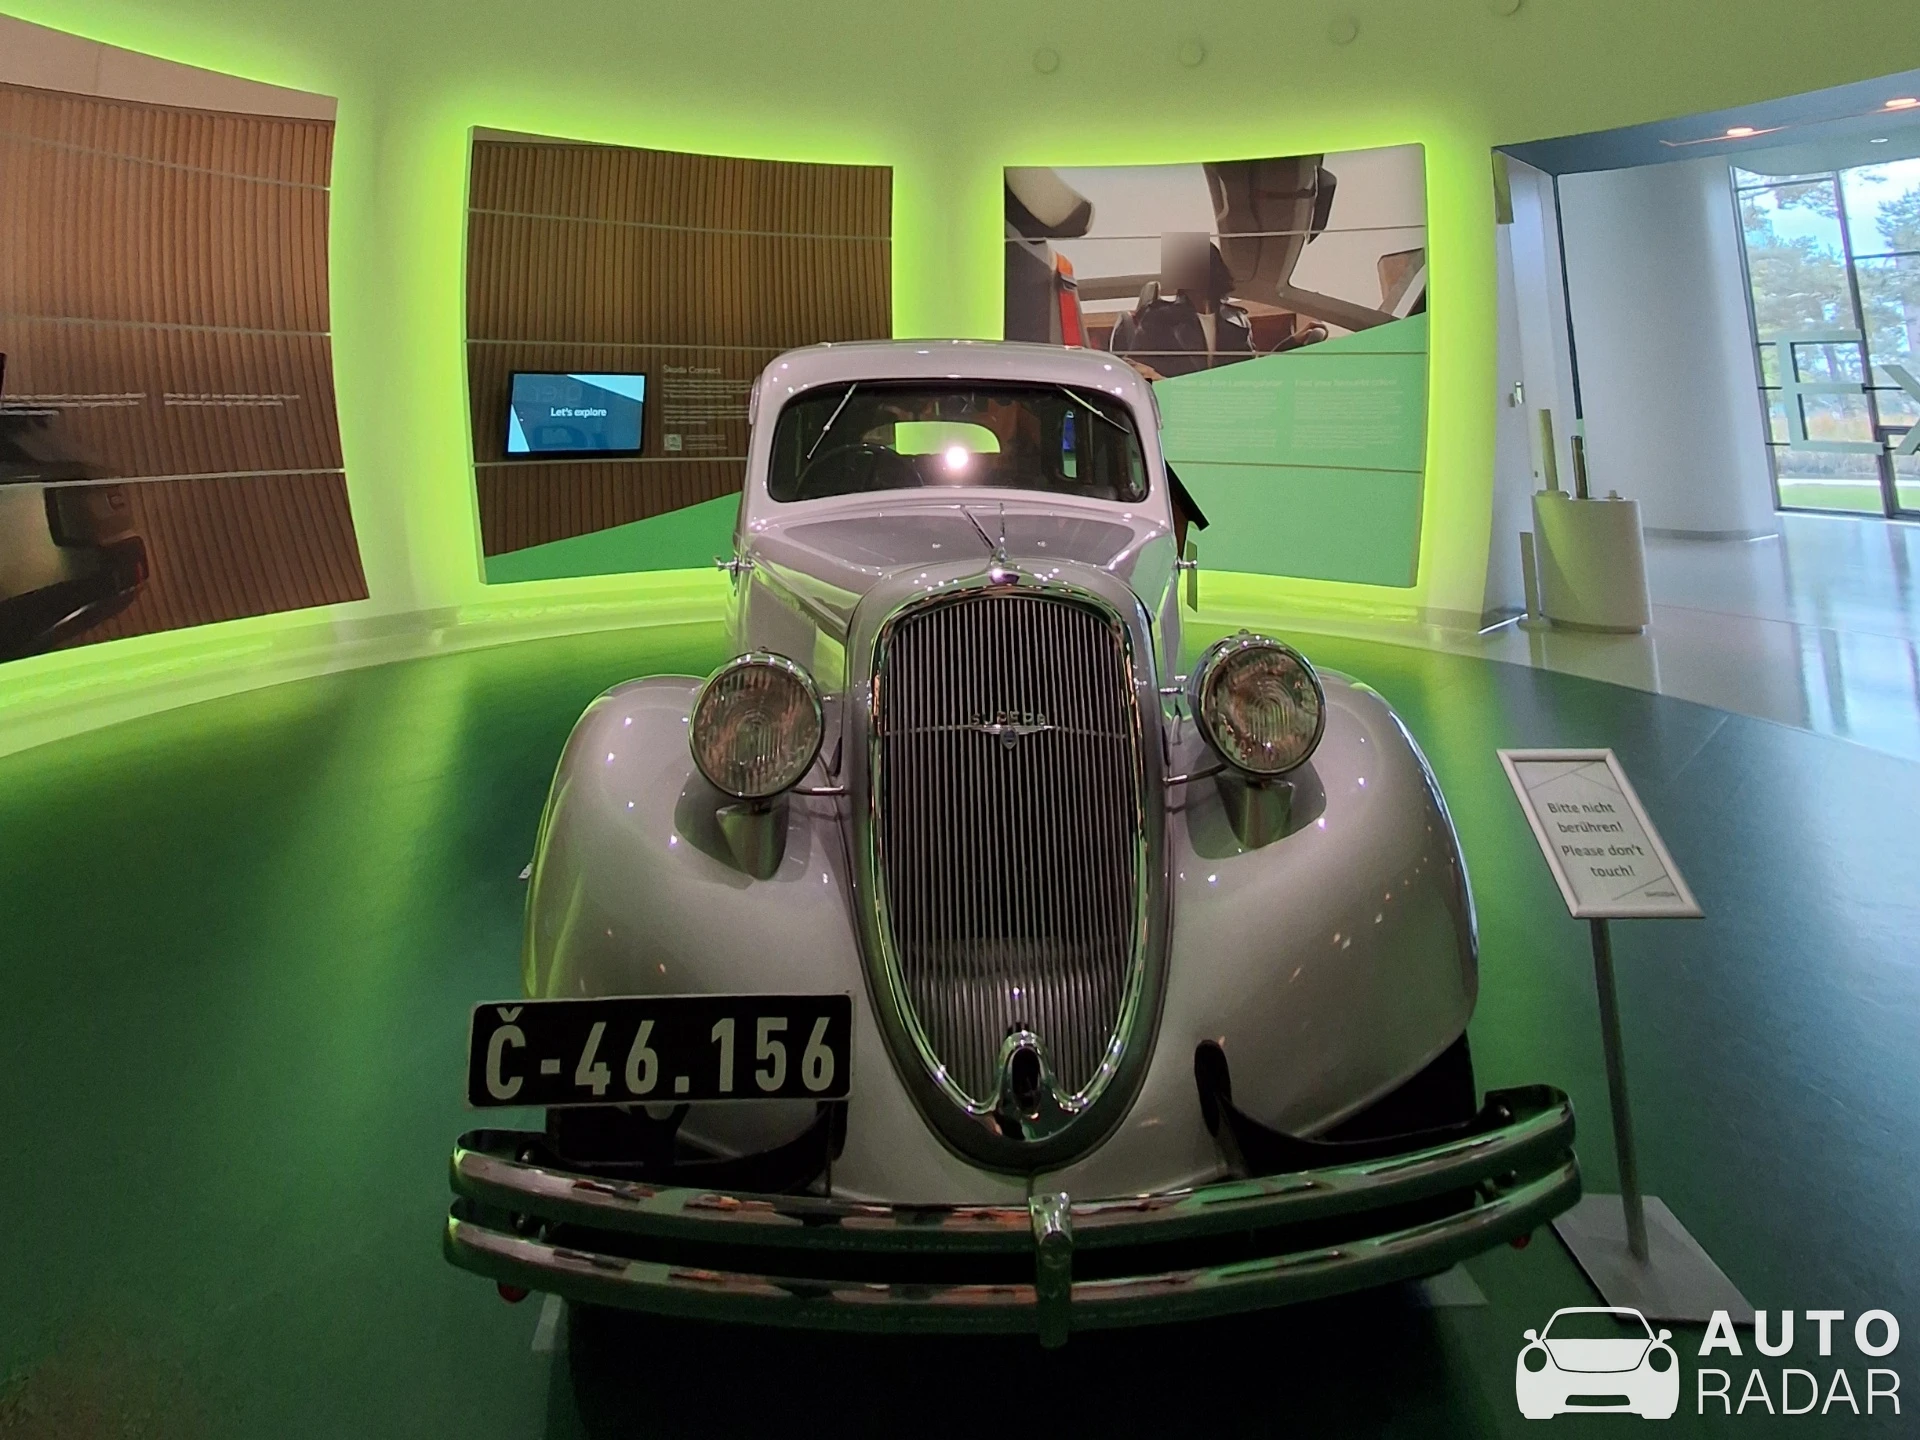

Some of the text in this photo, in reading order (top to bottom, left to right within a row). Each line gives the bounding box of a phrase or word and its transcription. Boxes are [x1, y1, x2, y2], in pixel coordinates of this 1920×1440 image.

[551, 407, 607, 418] Let's explore
[1547, 802, 1615, 814] Bitte nicht
[1557, 821, 1623, 833] berühren!
[1562, 845, 1644, 857] Please don't
[1591, 866, 1636, 877] touch!
[486, 1007, 836, 1100] Č-46.156
